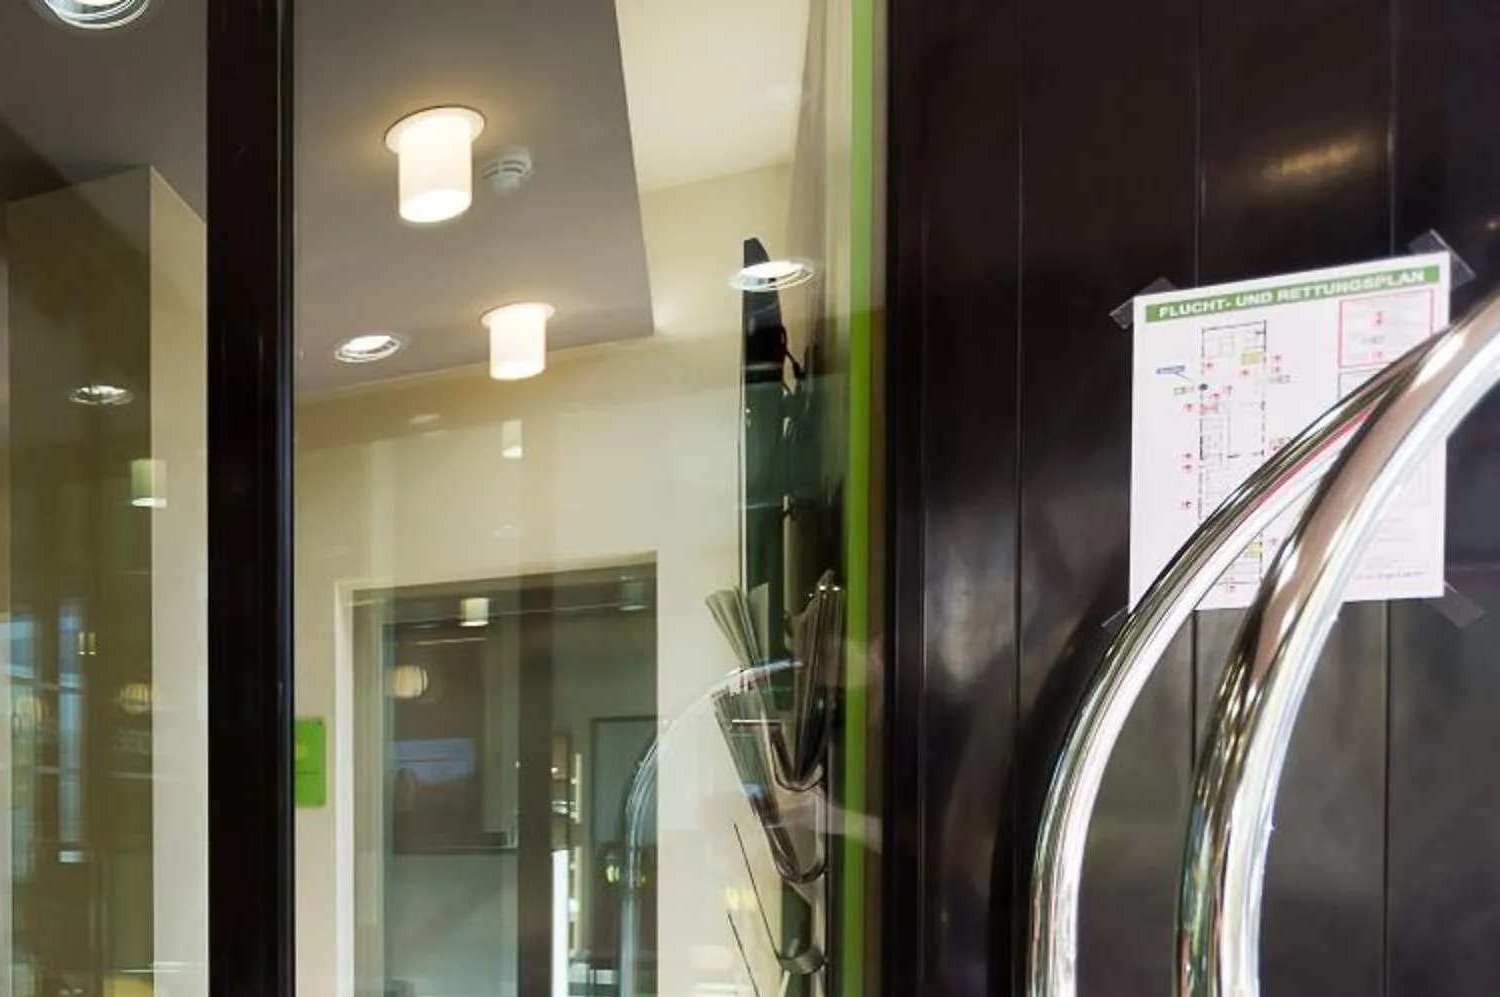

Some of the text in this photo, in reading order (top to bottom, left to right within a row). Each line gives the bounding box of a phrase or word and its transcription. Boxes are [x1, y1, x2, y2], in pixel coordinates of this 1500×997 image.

[1157, 270, 1425, 319] FLUCHT- UND RETTUNGSPLAN
